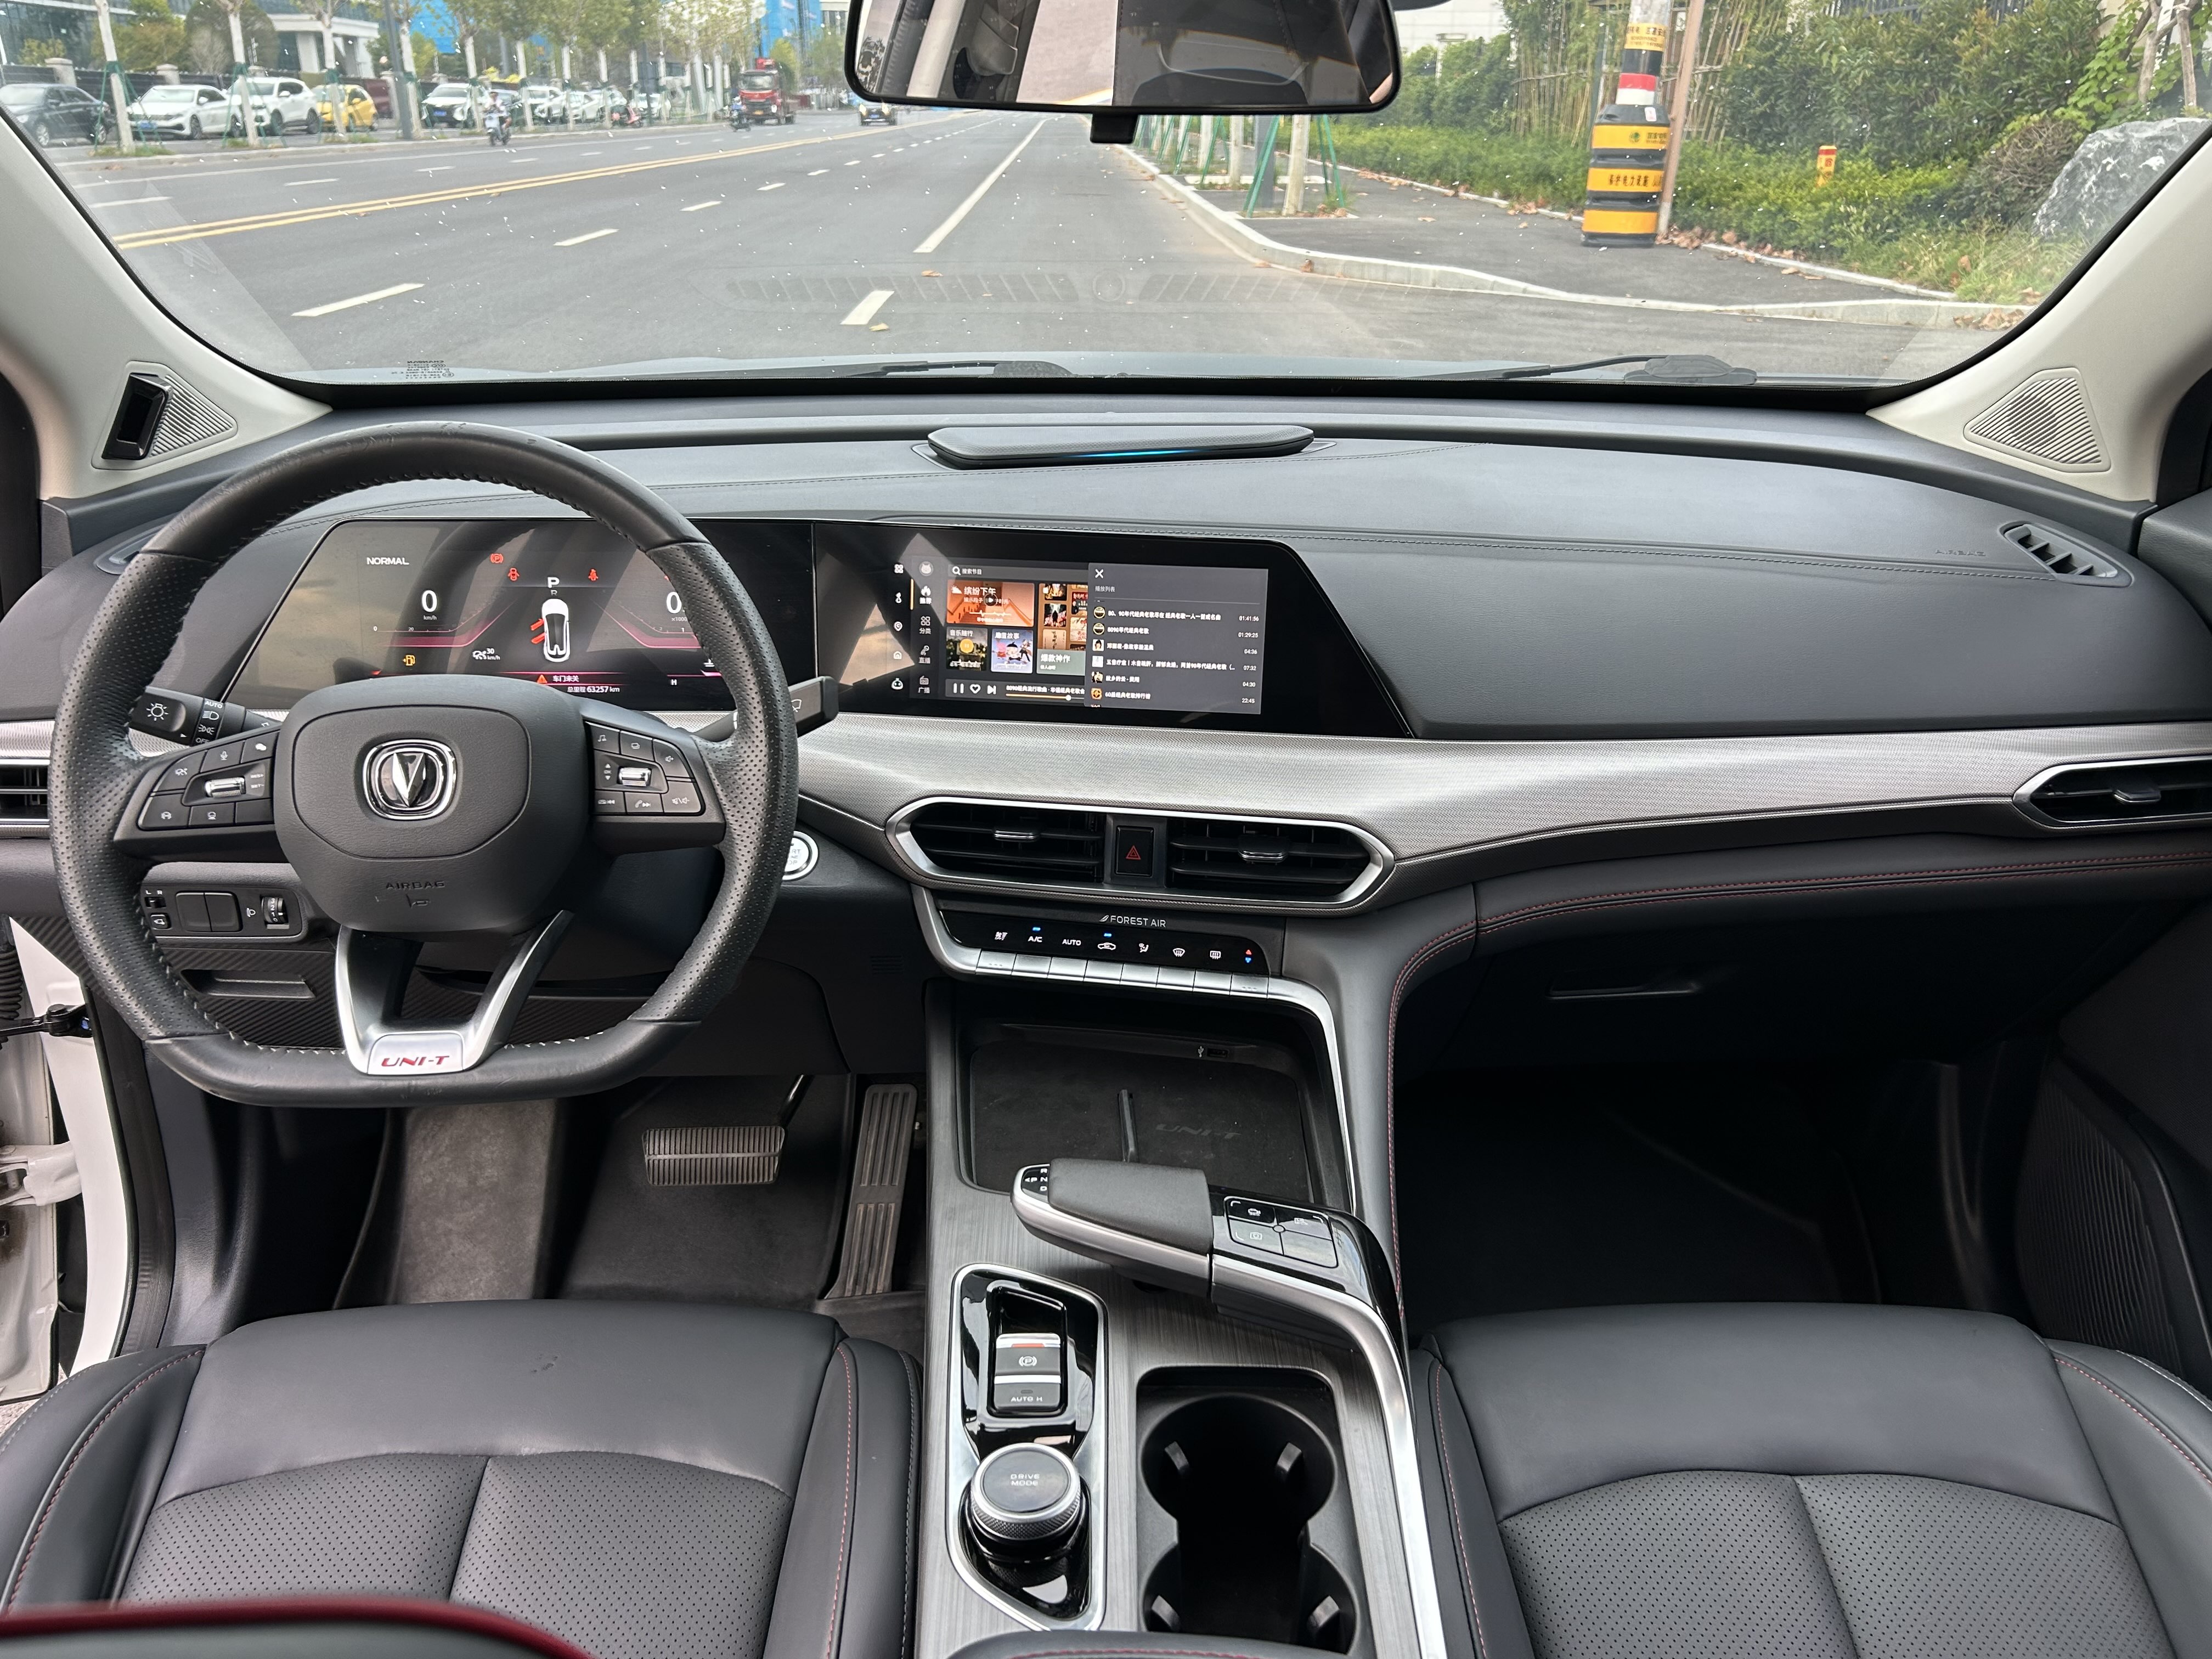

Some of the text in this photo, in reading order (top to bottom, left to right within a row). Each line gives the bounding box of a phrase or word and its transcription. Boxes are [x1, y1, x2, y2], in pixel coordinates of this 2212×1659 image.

[366, 557, 409, 565] NORMAL
[548, 577, 560, 588] P
[421, 590, 437, 612] 0
[205, 701, 223, 709] AUTO
[386, 881, 445, 889] AIRBAG
[1110, 915, 1166, 928] FOREST AIR
[381, 1055, 450, 1068] UNI-T
